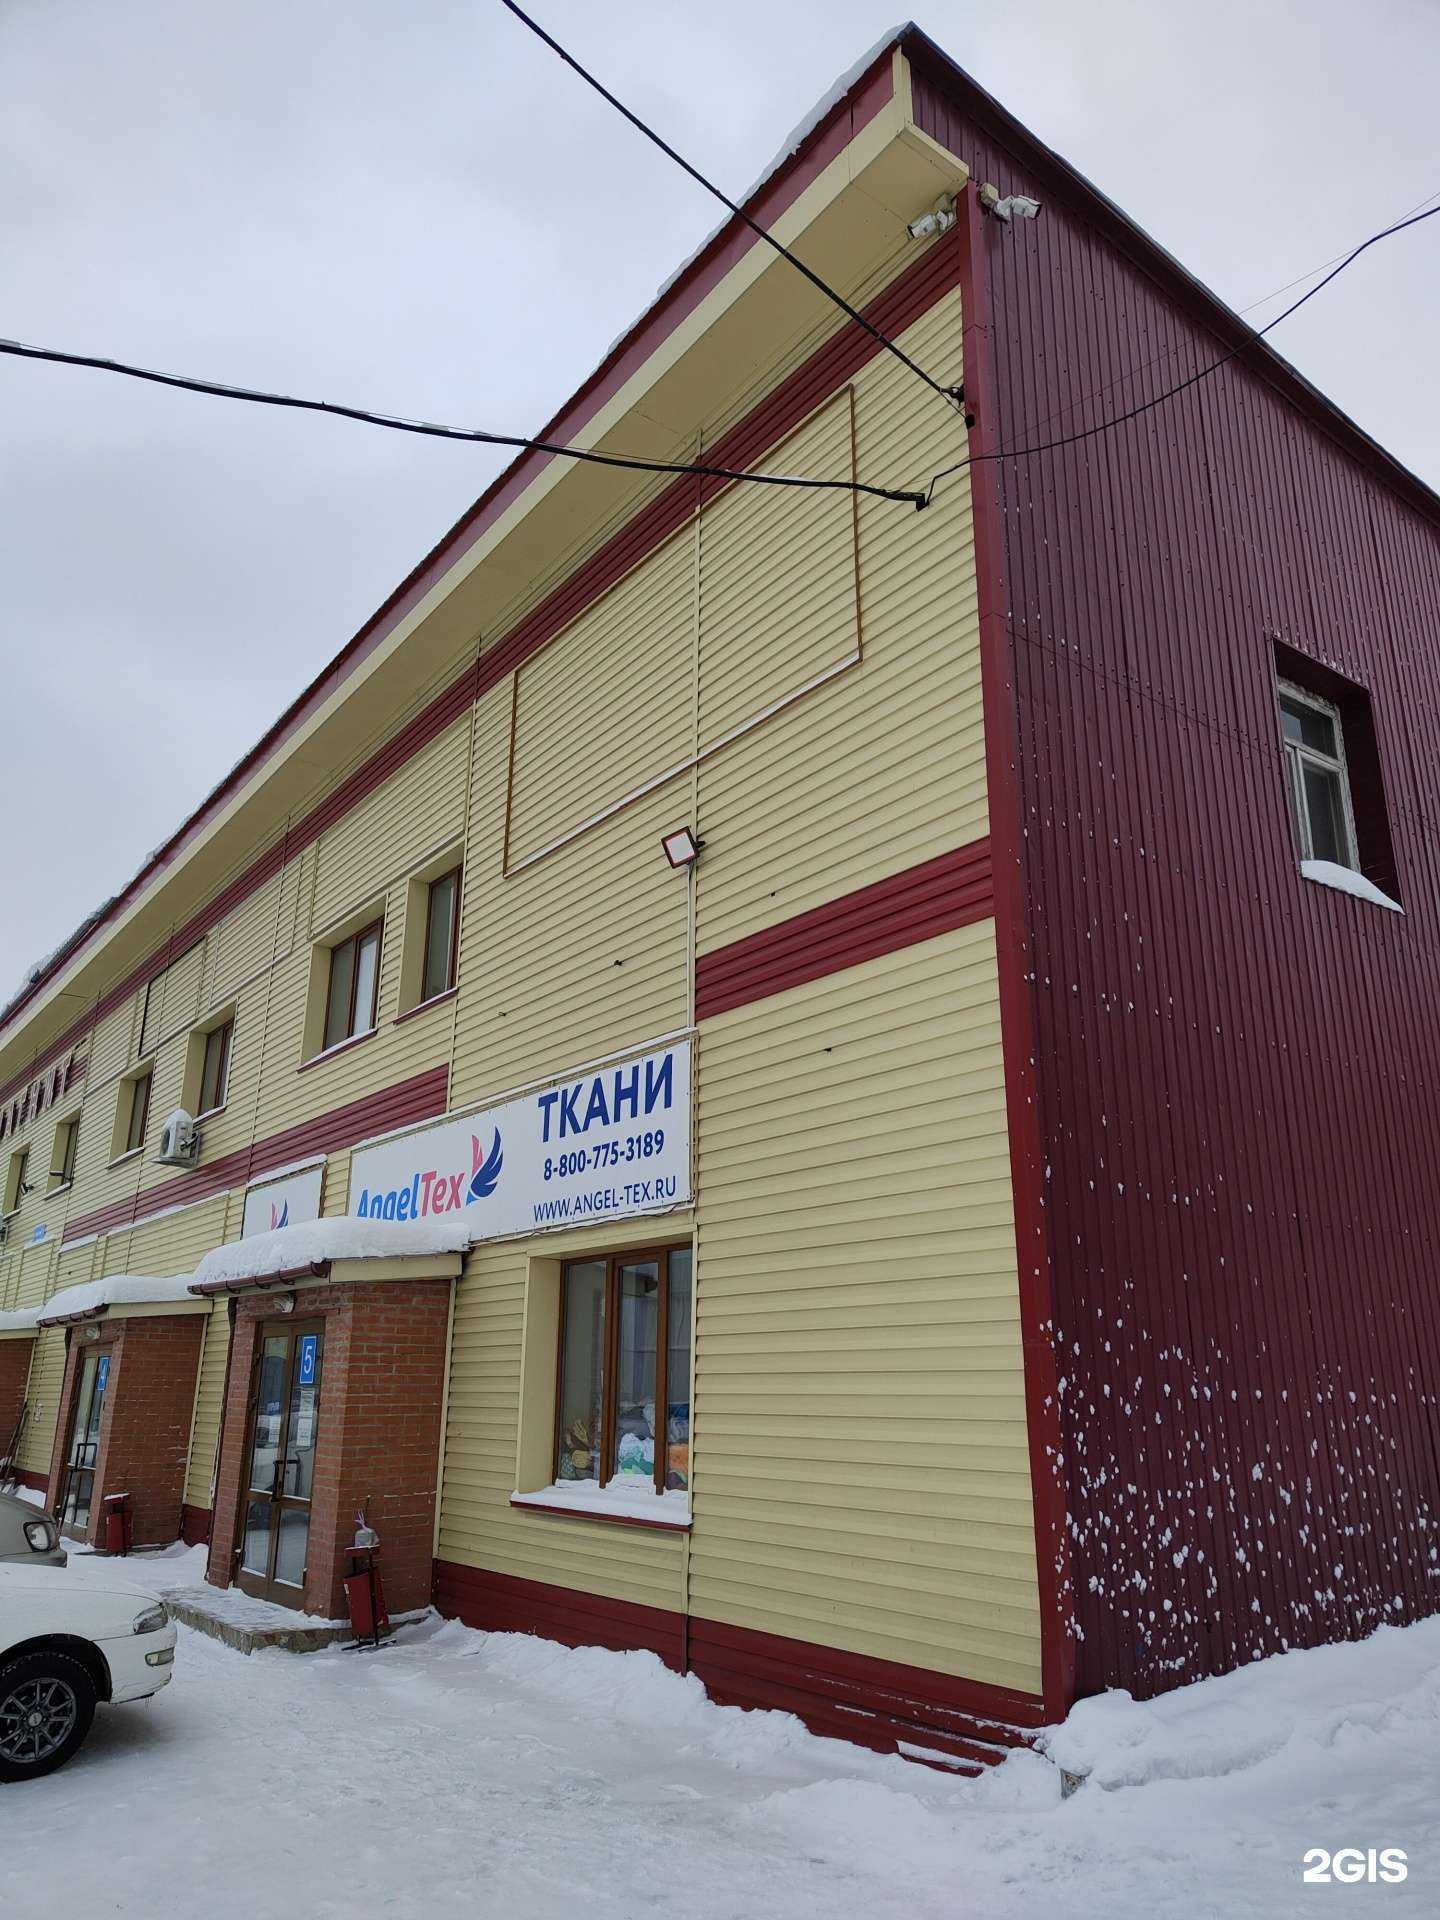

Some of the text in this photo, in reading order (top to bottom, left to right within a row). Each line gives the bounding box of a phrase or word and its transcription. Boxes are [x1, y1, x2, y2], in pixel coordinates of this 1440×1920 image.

[537, 1053, 673, 1143] ТКАНИ
[543, 1129, 665, 1181] 8-800-775-3189
[533, 1175, 676, 1223] WWW.ANGEL-TEX.RU
[303, 1345, 313, 1374] 5
